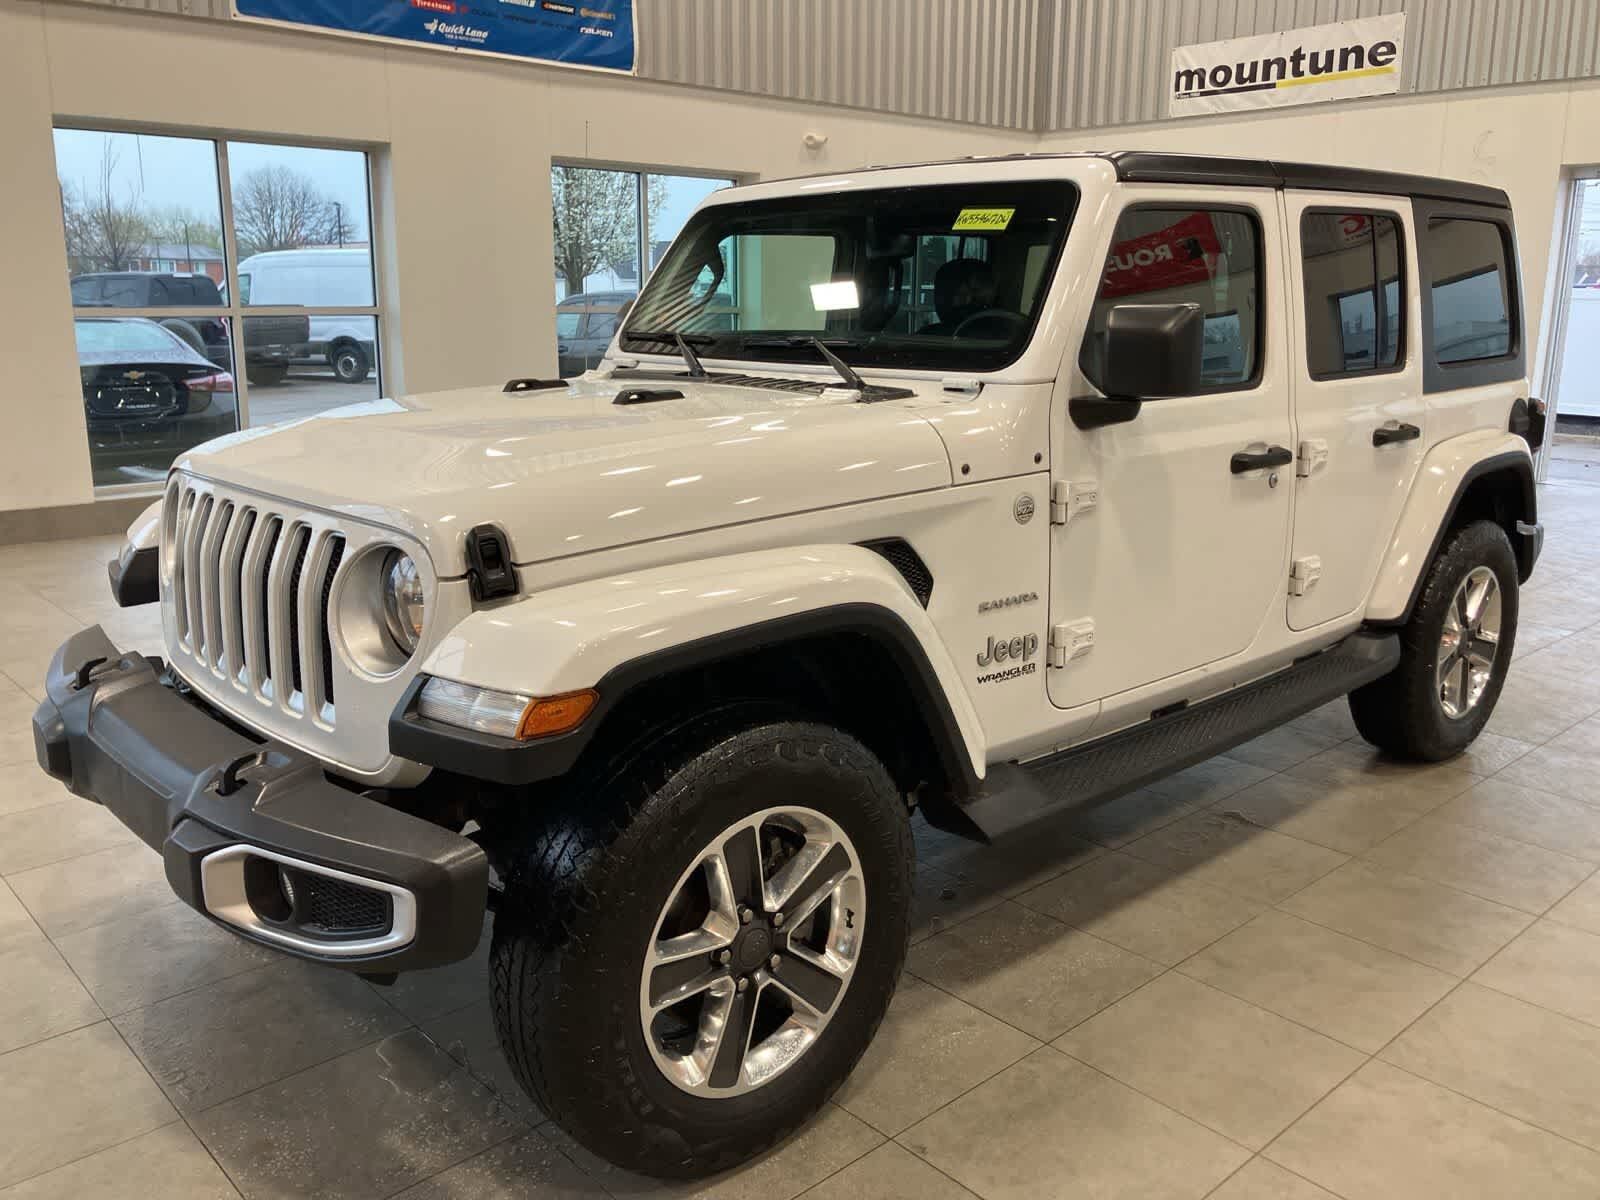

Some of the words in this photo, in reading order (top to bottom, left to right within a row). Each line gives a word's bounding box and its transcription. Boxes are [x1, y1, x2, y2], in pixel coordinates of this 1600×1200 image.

[438, 21, 465, 35] Quick
[465, 26, 489, 39] Lane
[1174, 40, 1398, 93] mountune
[978, 591, 1039, 614] SAHARA
[976, 633, 1038, 667] Jeep
[976, 662, 1036, 684] WRANGLER
